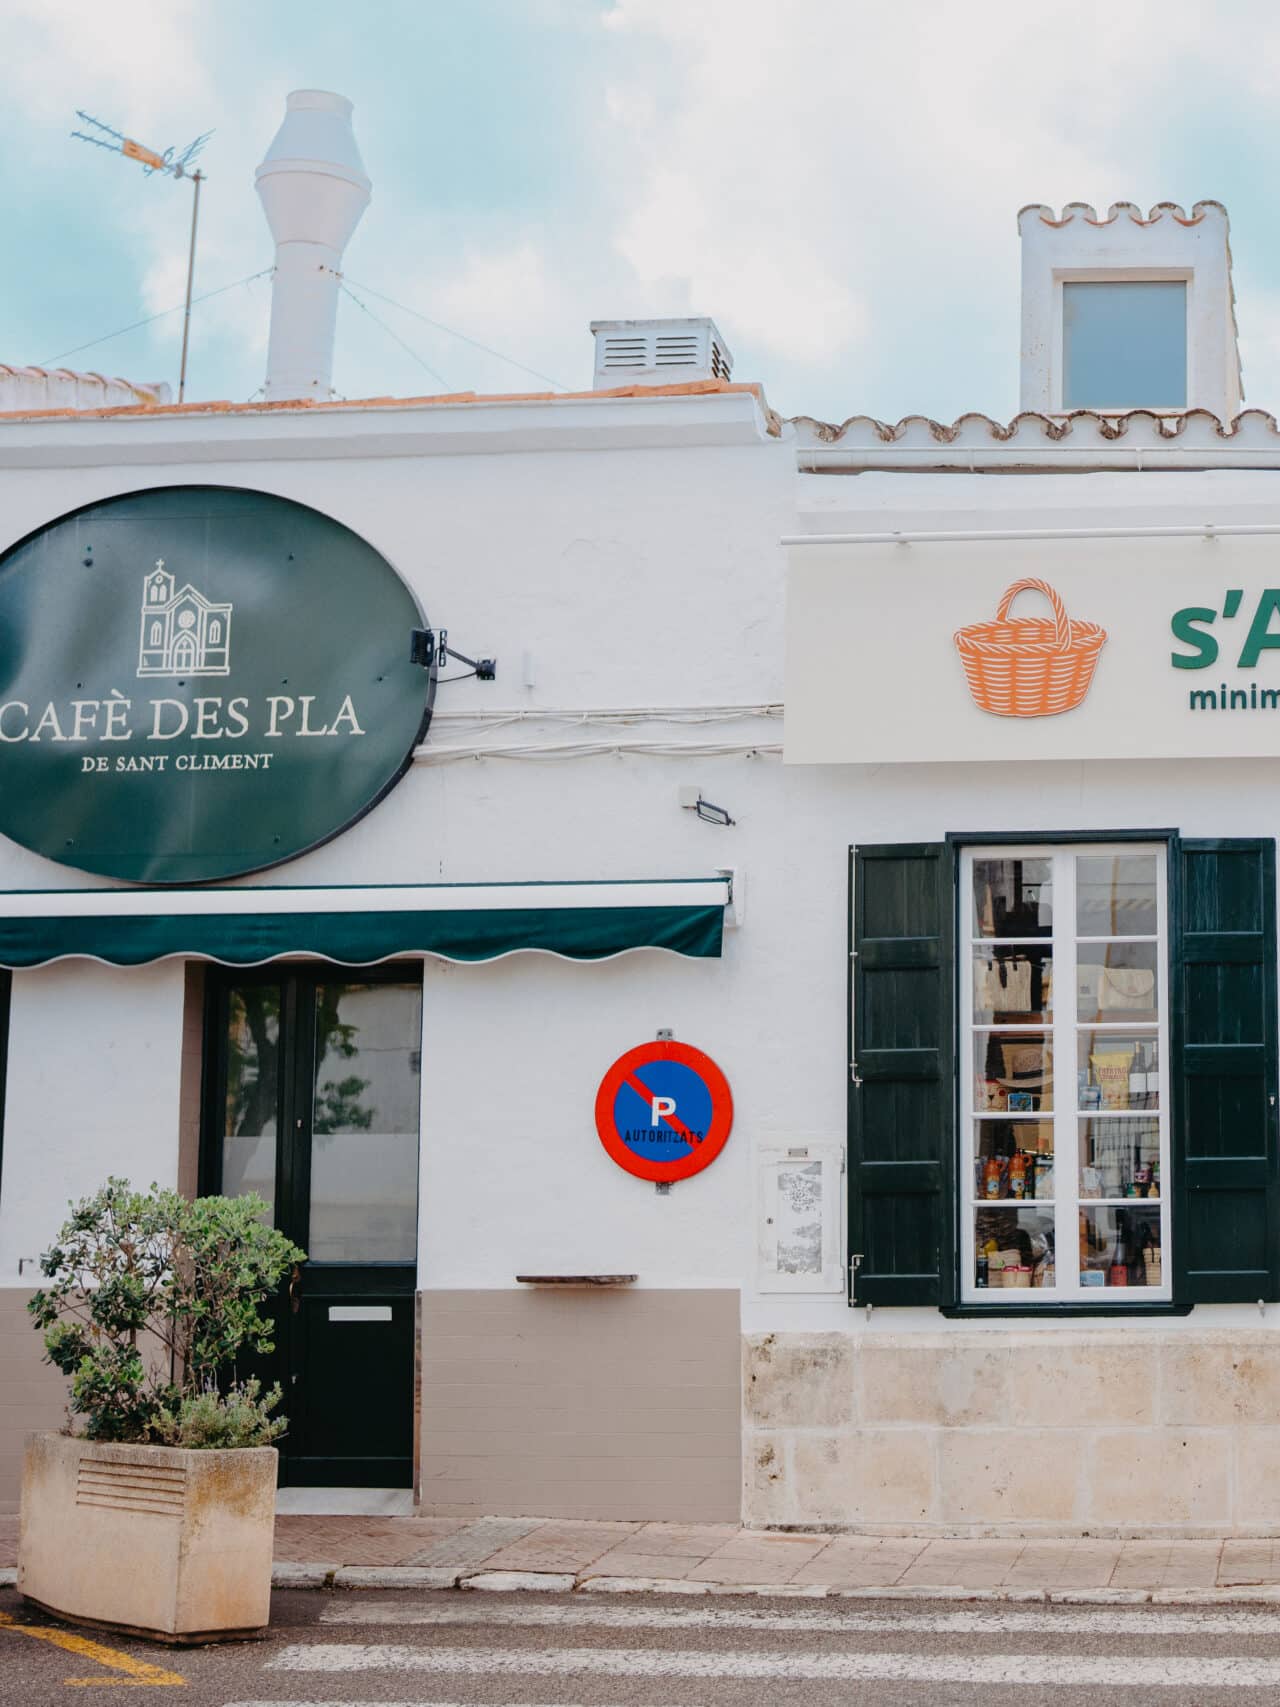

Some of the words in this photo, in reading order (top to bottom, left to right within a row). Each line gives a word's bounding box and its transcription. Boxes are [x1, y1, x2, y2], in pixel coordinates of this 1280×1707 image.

[0, 688, 132, 742] CAFÈ
[147, 697, 249, 741] DES
[264, 694, 366, 738] PLA
[81, 756, 109, 772] DE
[115, 755, 169, 772] SANT
[175, 753, 273, 771] CLIMENT
[651, 1096, 677, 1127] P
[625, 1129, 703, 1143] AUTORITZATS
